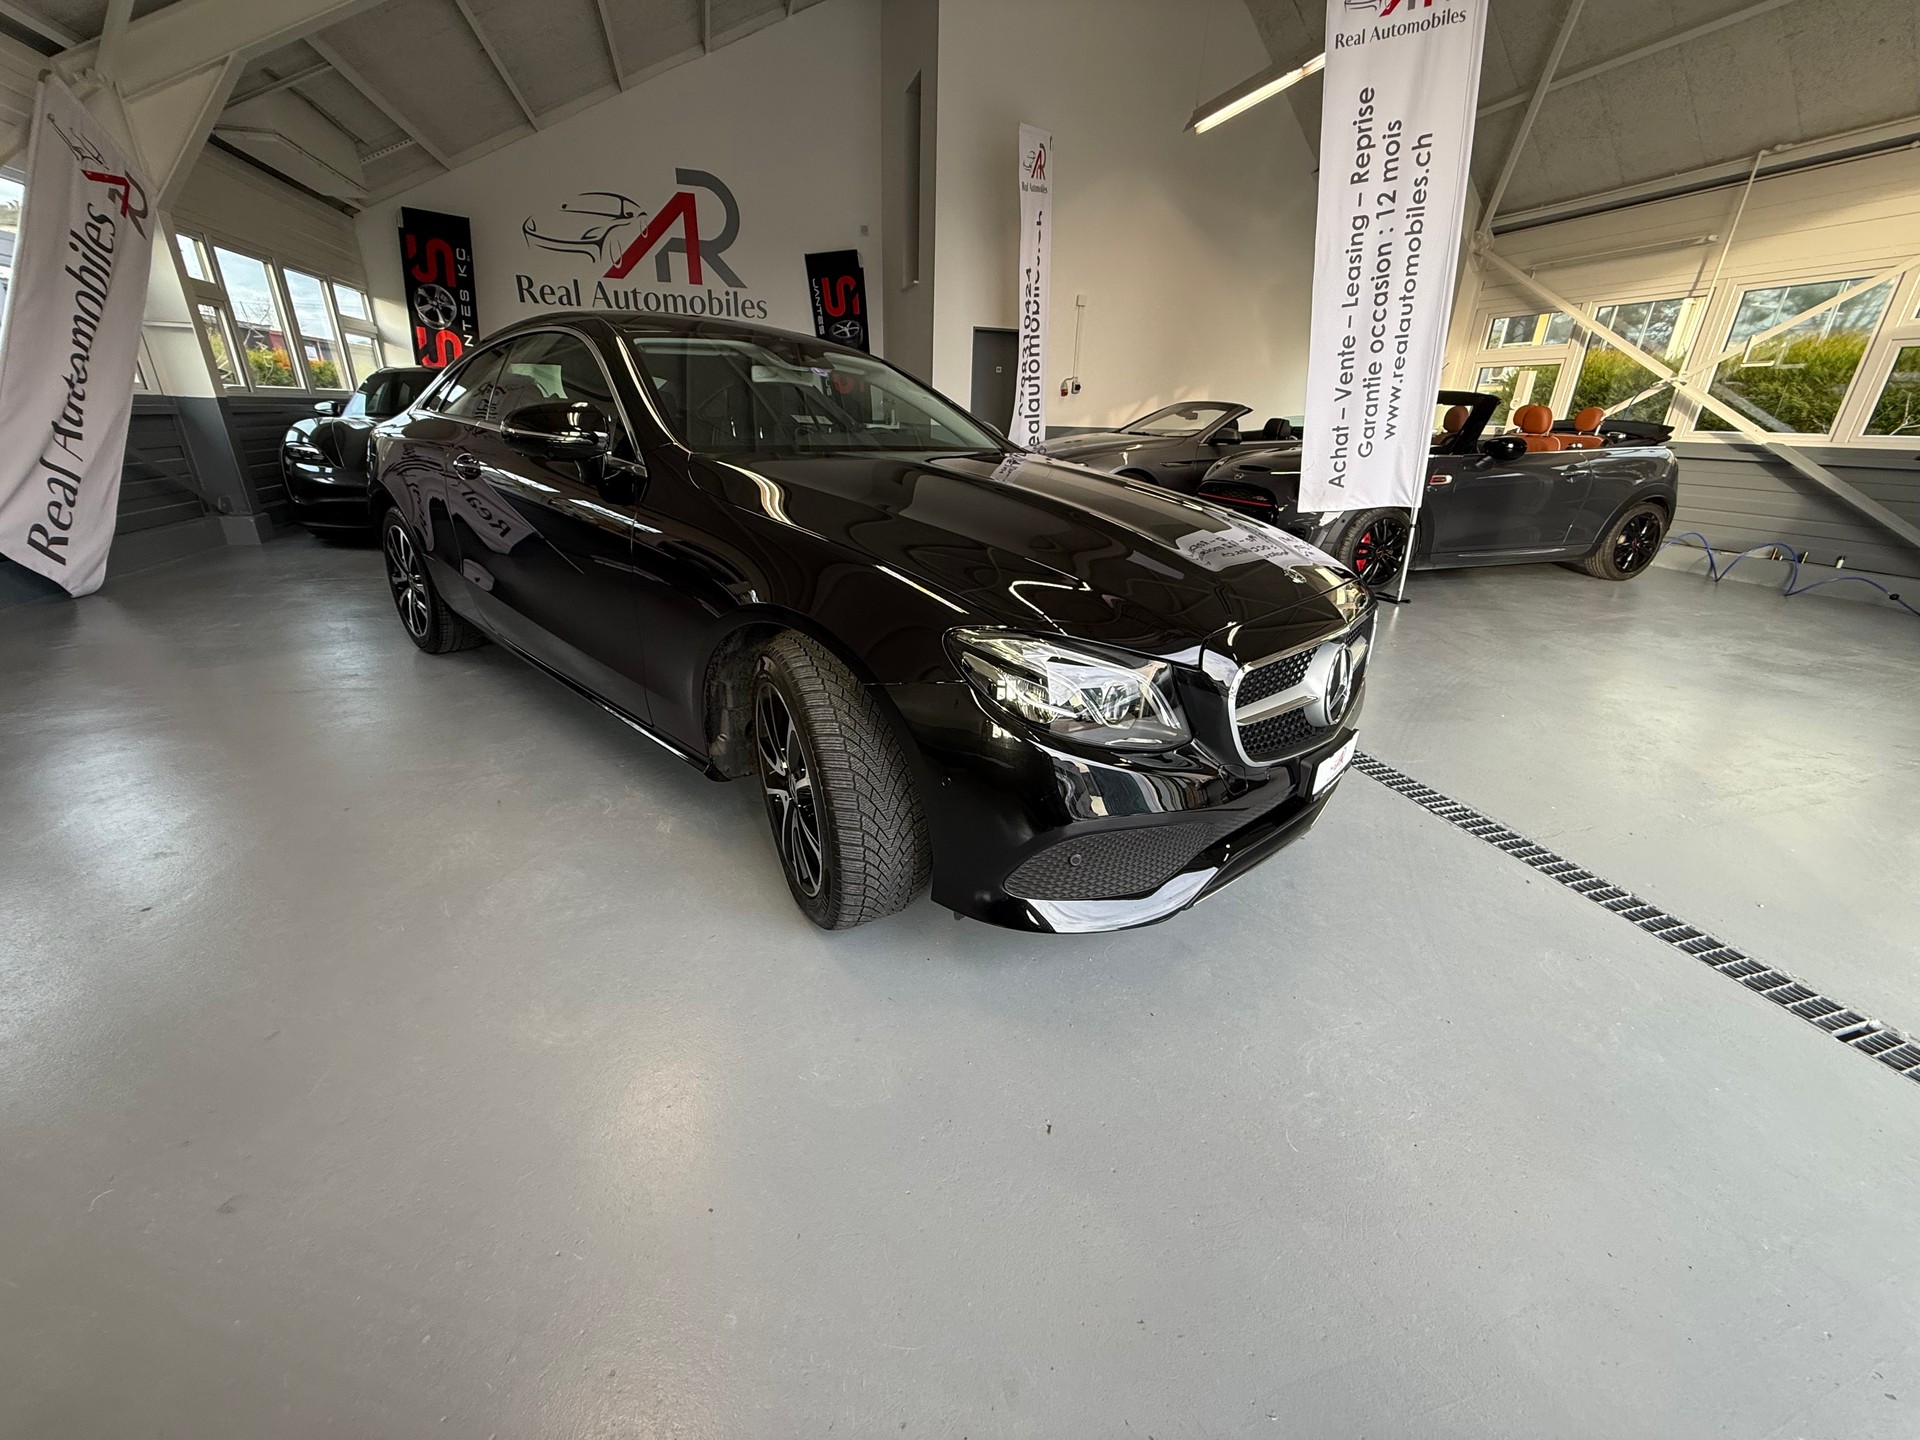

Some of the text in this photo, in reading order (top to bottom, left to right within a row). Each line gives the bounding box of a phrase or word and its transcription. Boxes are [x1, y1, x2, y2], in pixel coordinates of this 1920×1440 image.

[1335, 9, 1466, 49] Real Automobiles
[1350, 87, 1376, 186] Reprise
[1383, 119, 1402, 183] mois
[1376, 189, 1397, 221] 12
[1341, 214, 1370, 309] Leasing
[1383, 132, 1433, 441] www.realautomobiles.ch
[461, 289, 475, 347] NTES
[515, 274, 768, 319] Real Automobiles
[812, 278, 827, 336] JANTES
[1370, 241, 1392, 353] occasion
[27, 202, 117, 566] Real Automobiles
[1334, 335, 1356, 402] Vente
[1358, 361, 1384, 458] Garantie
[1328, 425, 1349, 488] Achat
